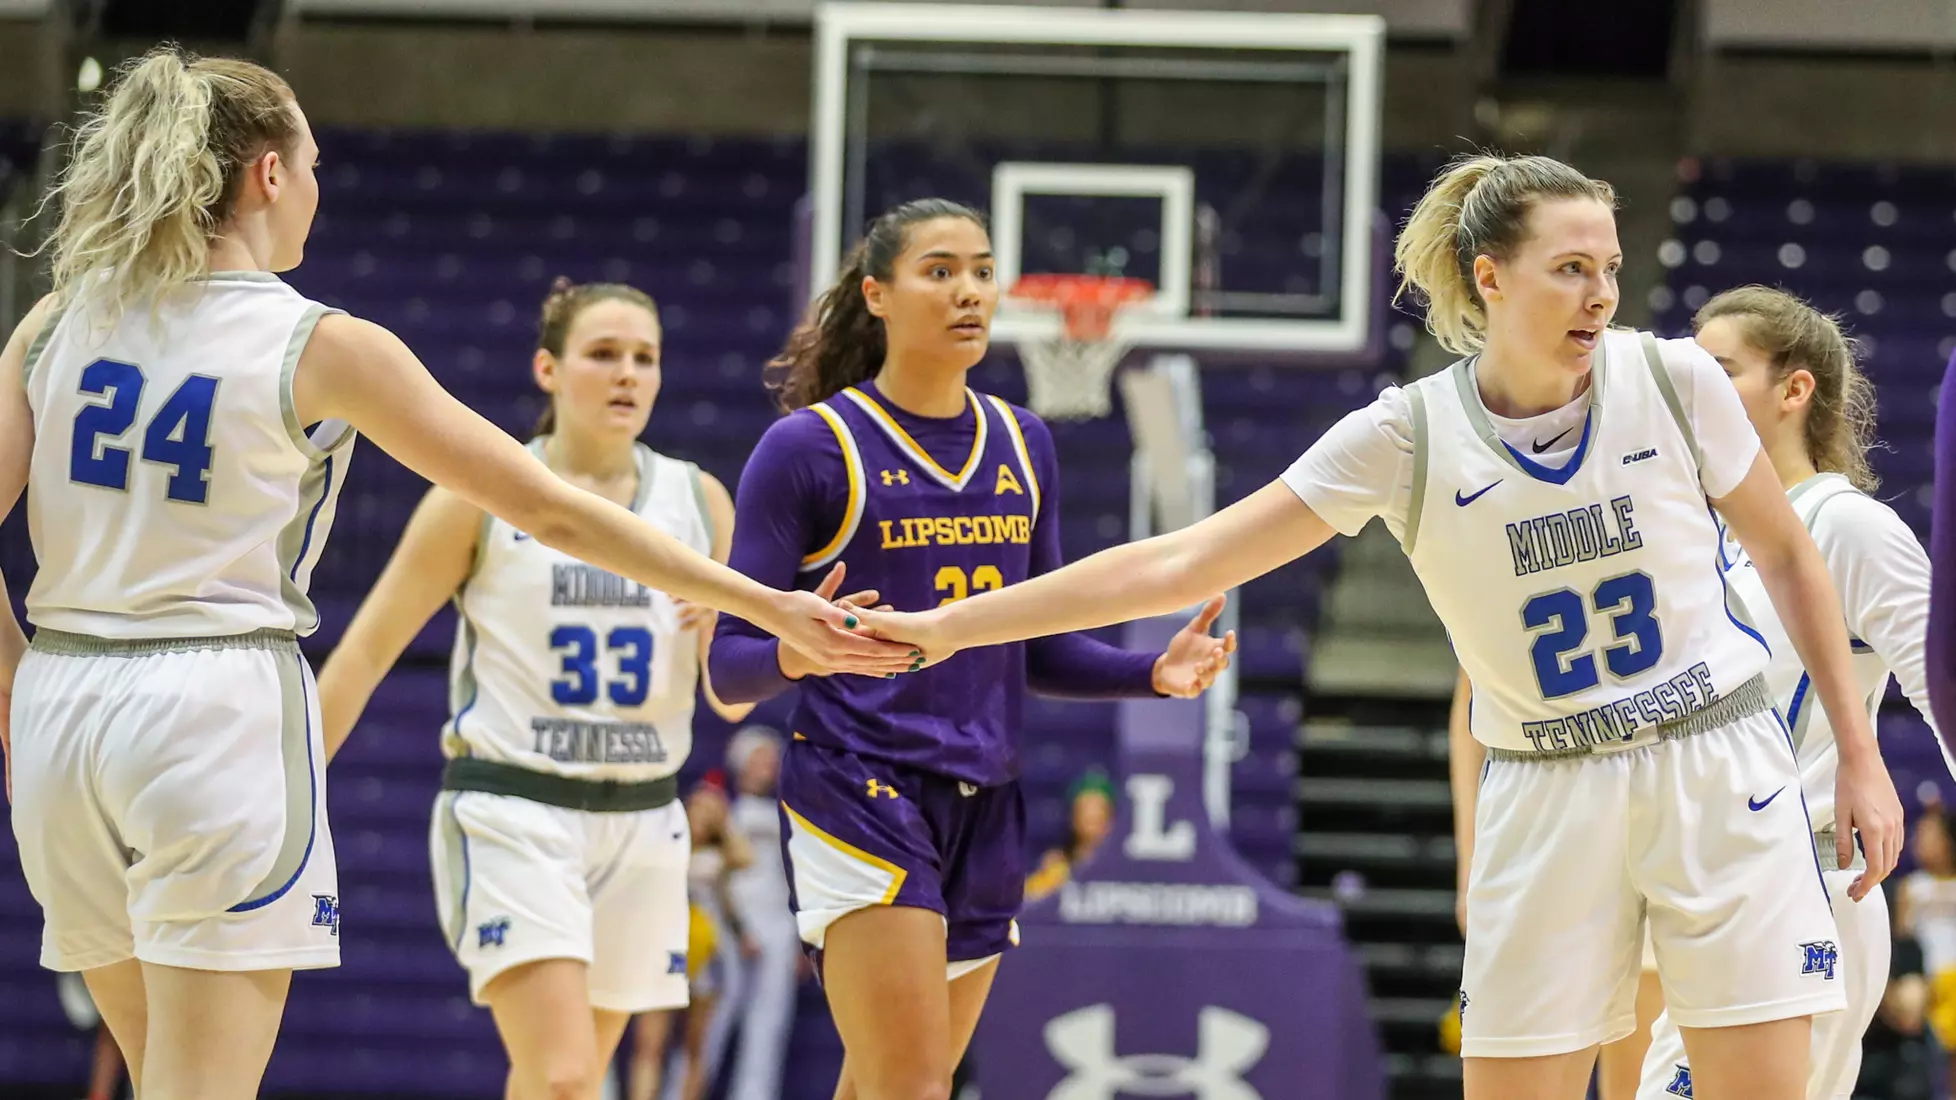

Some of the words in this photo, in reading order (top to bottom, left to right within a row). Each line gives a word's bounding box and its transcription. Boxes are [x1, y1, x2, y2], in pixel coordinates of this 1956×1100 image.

[69, 356, 223, 506] 24
[879, 515, 1031, 549] LIPSCOMB
[1506, 495, 1643, 576] MIDDLE
[549, 624, 654, 706] 33
[1519, 568, 1664, 700] 23
[1522, 661, 1719, 751] TENNESSEE
[1124, 773, 1196, 862] L
[1800, 941, 1837, 980] MT
